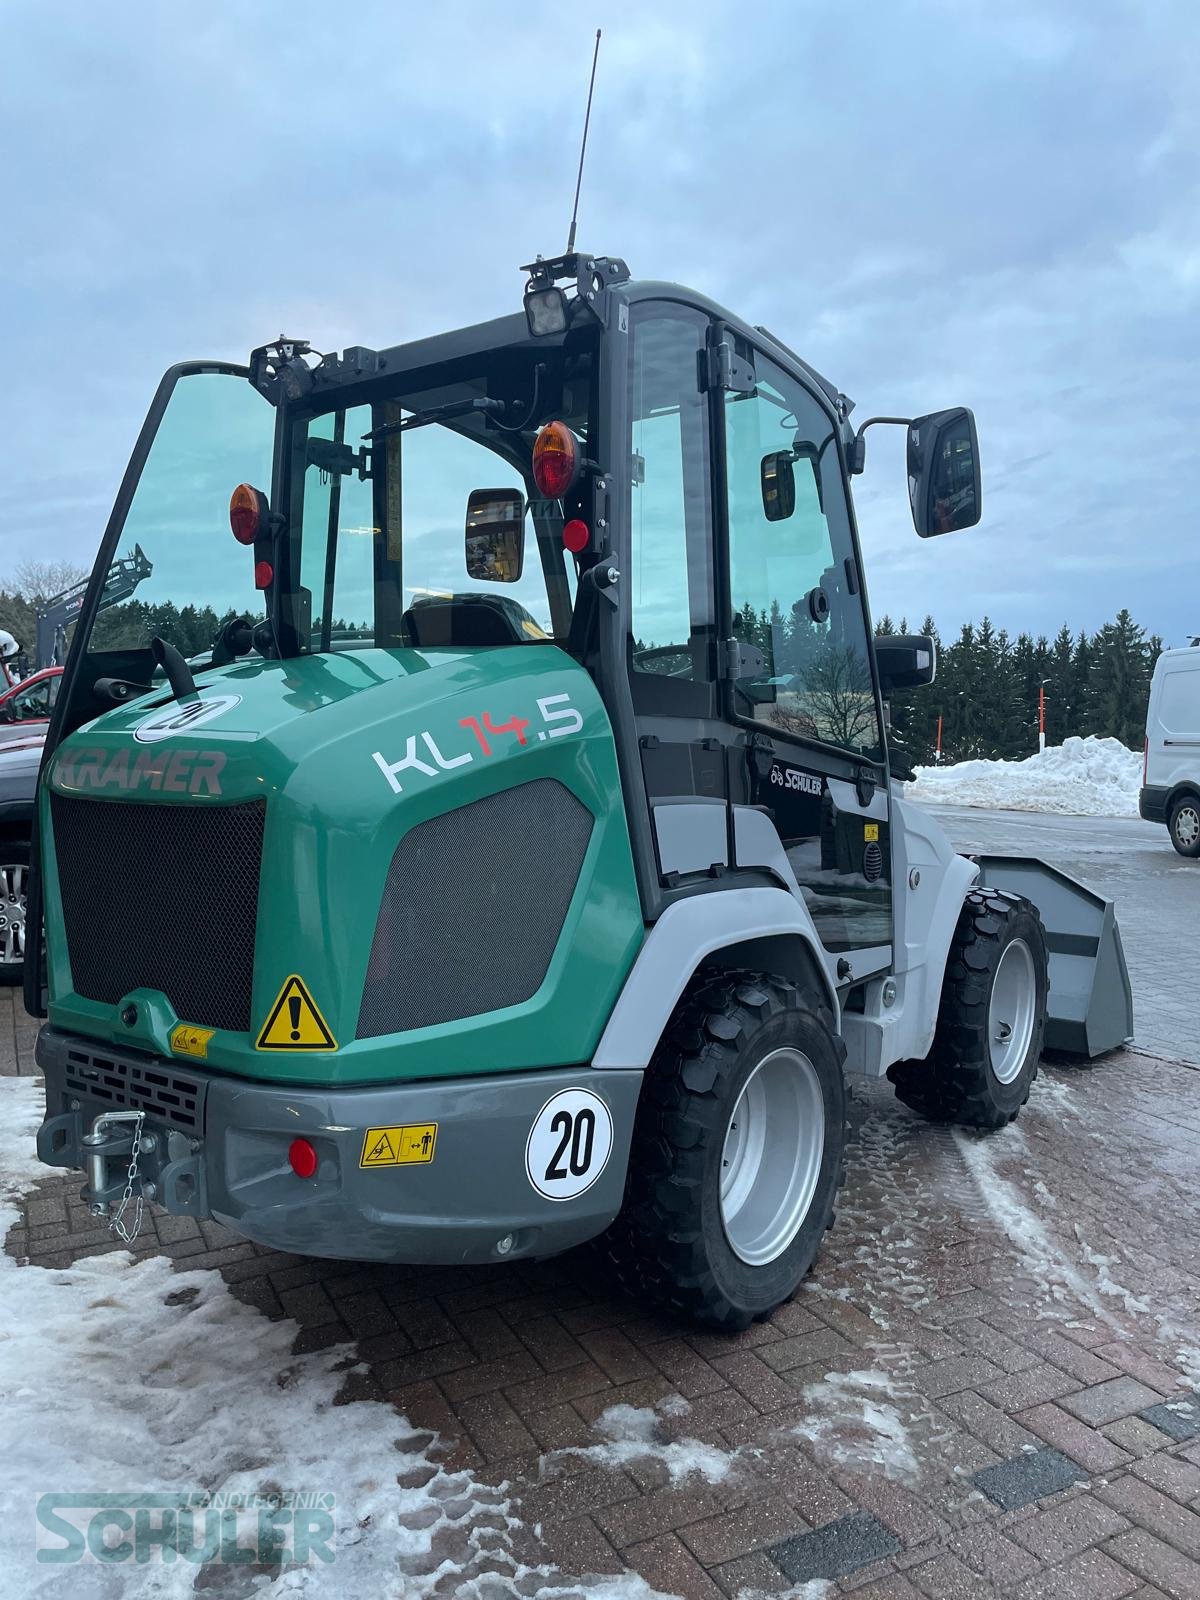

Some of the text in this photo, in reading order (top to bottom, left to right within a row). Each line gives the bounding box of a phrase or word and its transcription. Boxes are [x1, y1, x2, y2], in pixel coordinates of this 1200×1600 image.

[146, 701, 226, 731] 20
[52, 748, 227, 795] KRAMER
[784, 768, 822, 796] SCHULER
[544, 1108, 596, 1181] 20
